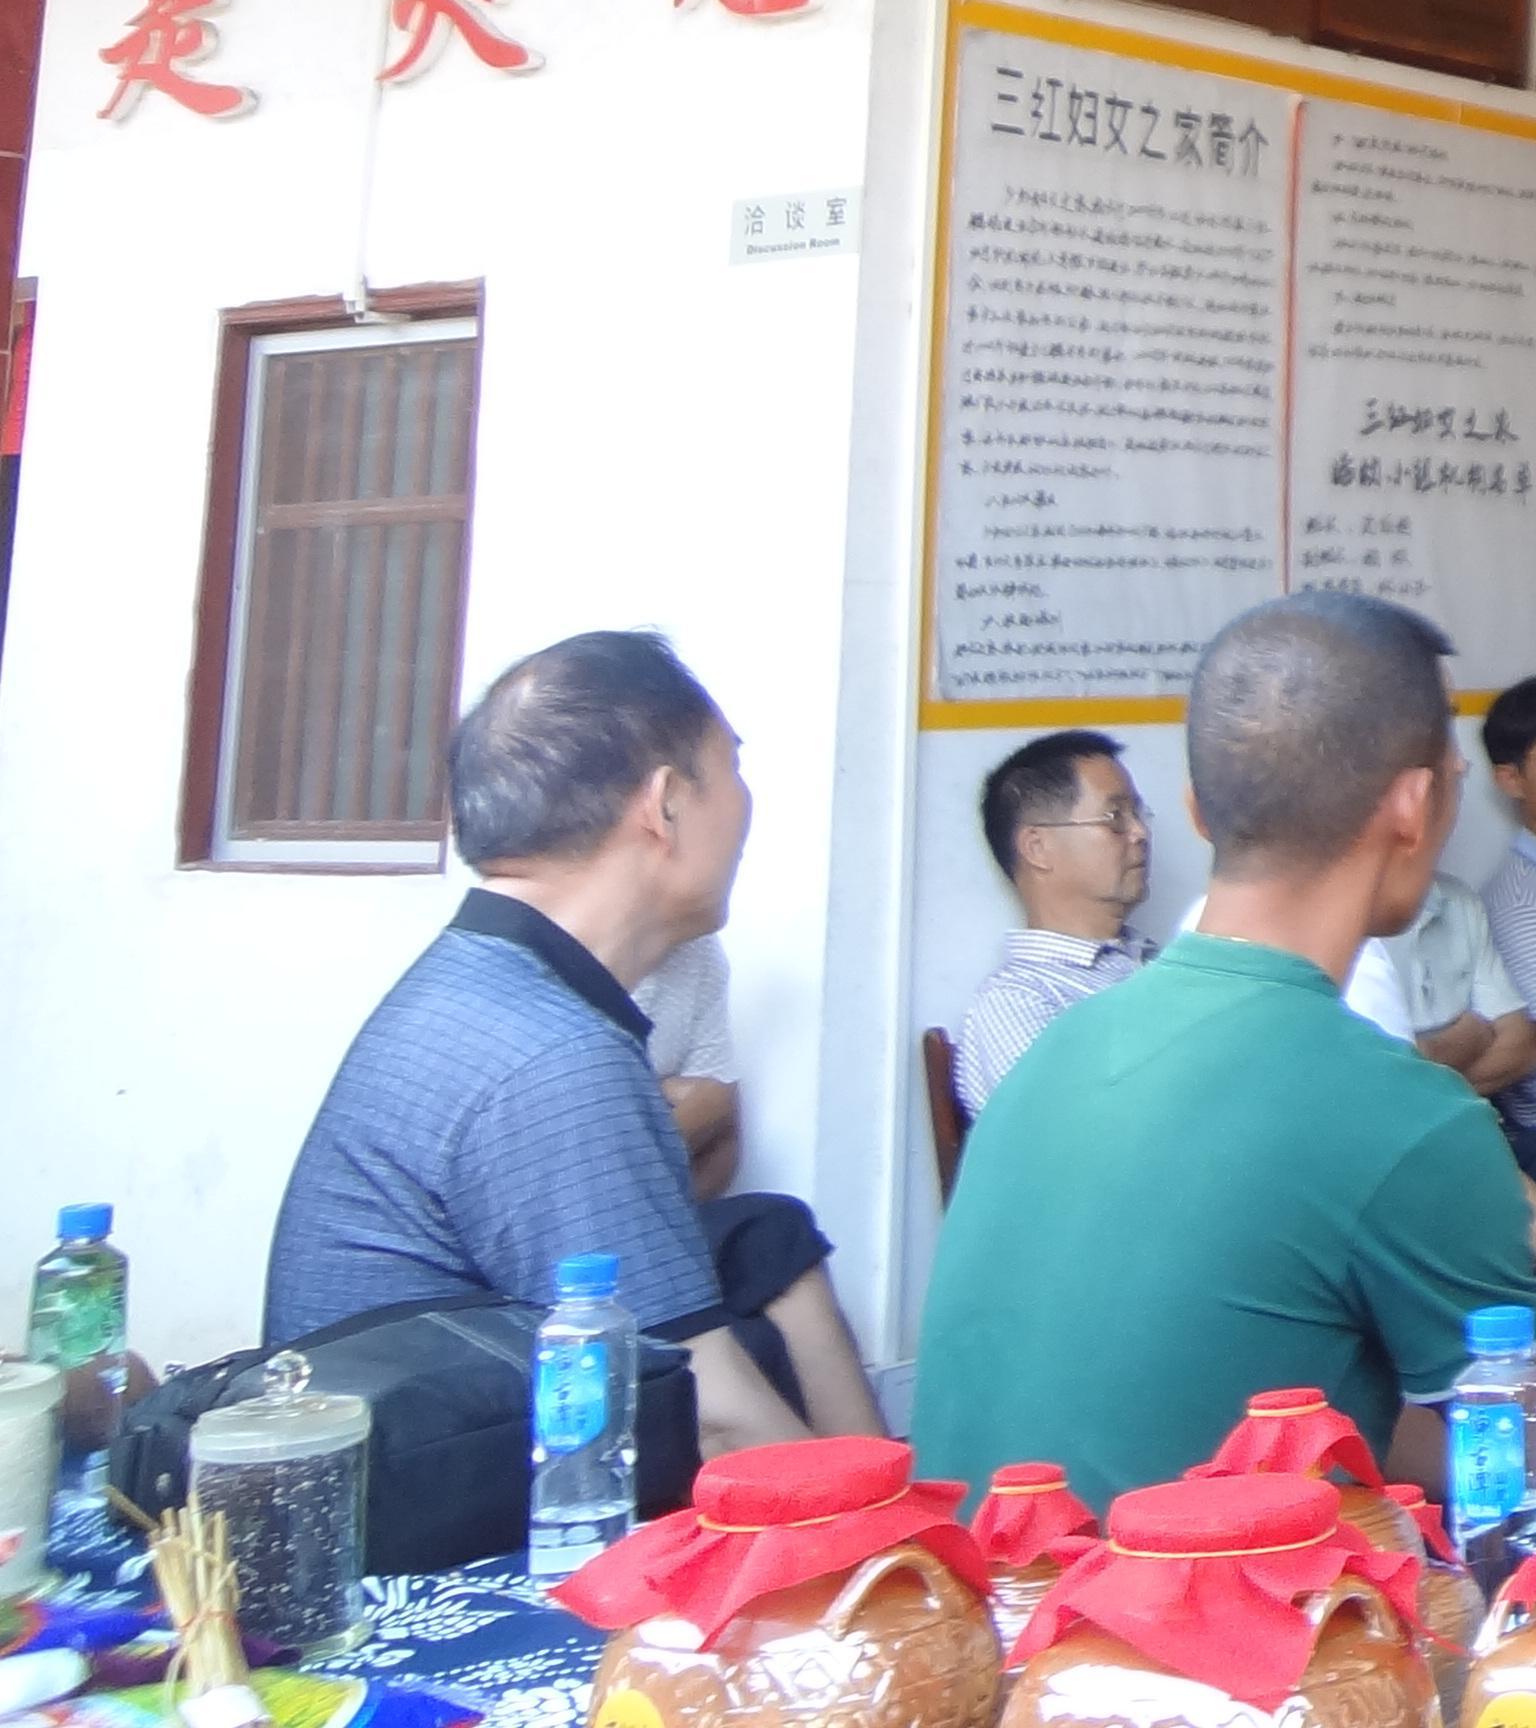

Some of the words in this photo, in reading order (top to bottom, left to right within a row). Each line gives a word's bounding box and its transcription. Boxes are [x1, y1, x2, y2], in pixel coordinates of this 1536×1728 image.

[744, 196, 848, 236] 洽谈室
[809, 237, 841, 250] Room
